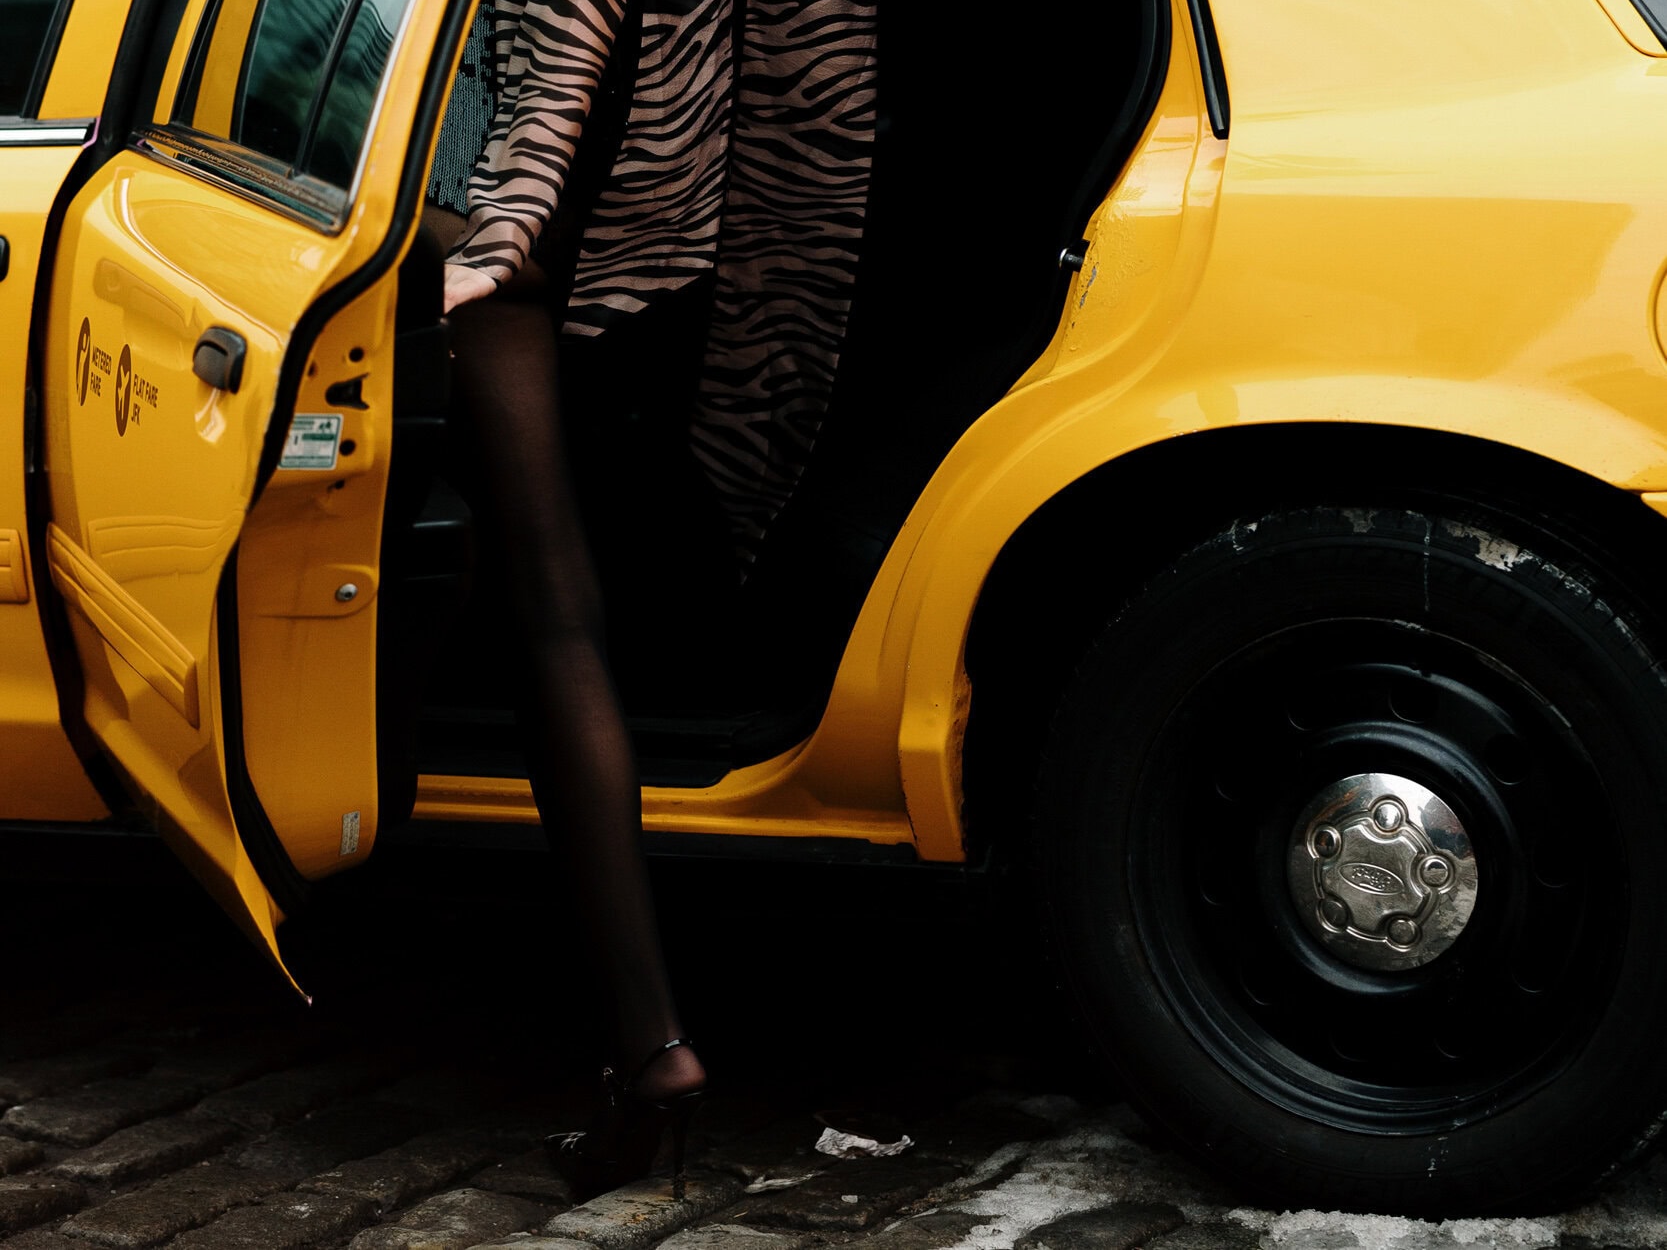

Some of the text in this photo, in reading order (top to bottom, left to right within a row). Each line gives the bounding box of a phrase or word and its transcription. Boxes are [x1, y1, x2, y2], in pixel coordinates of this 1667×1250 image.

[92, 345, 112, 375] METERED
[90, 372, 101, 397] FARE
[133, 373, 158, 408] FLAT FARE
[131, 403, 141, 426] JFK
